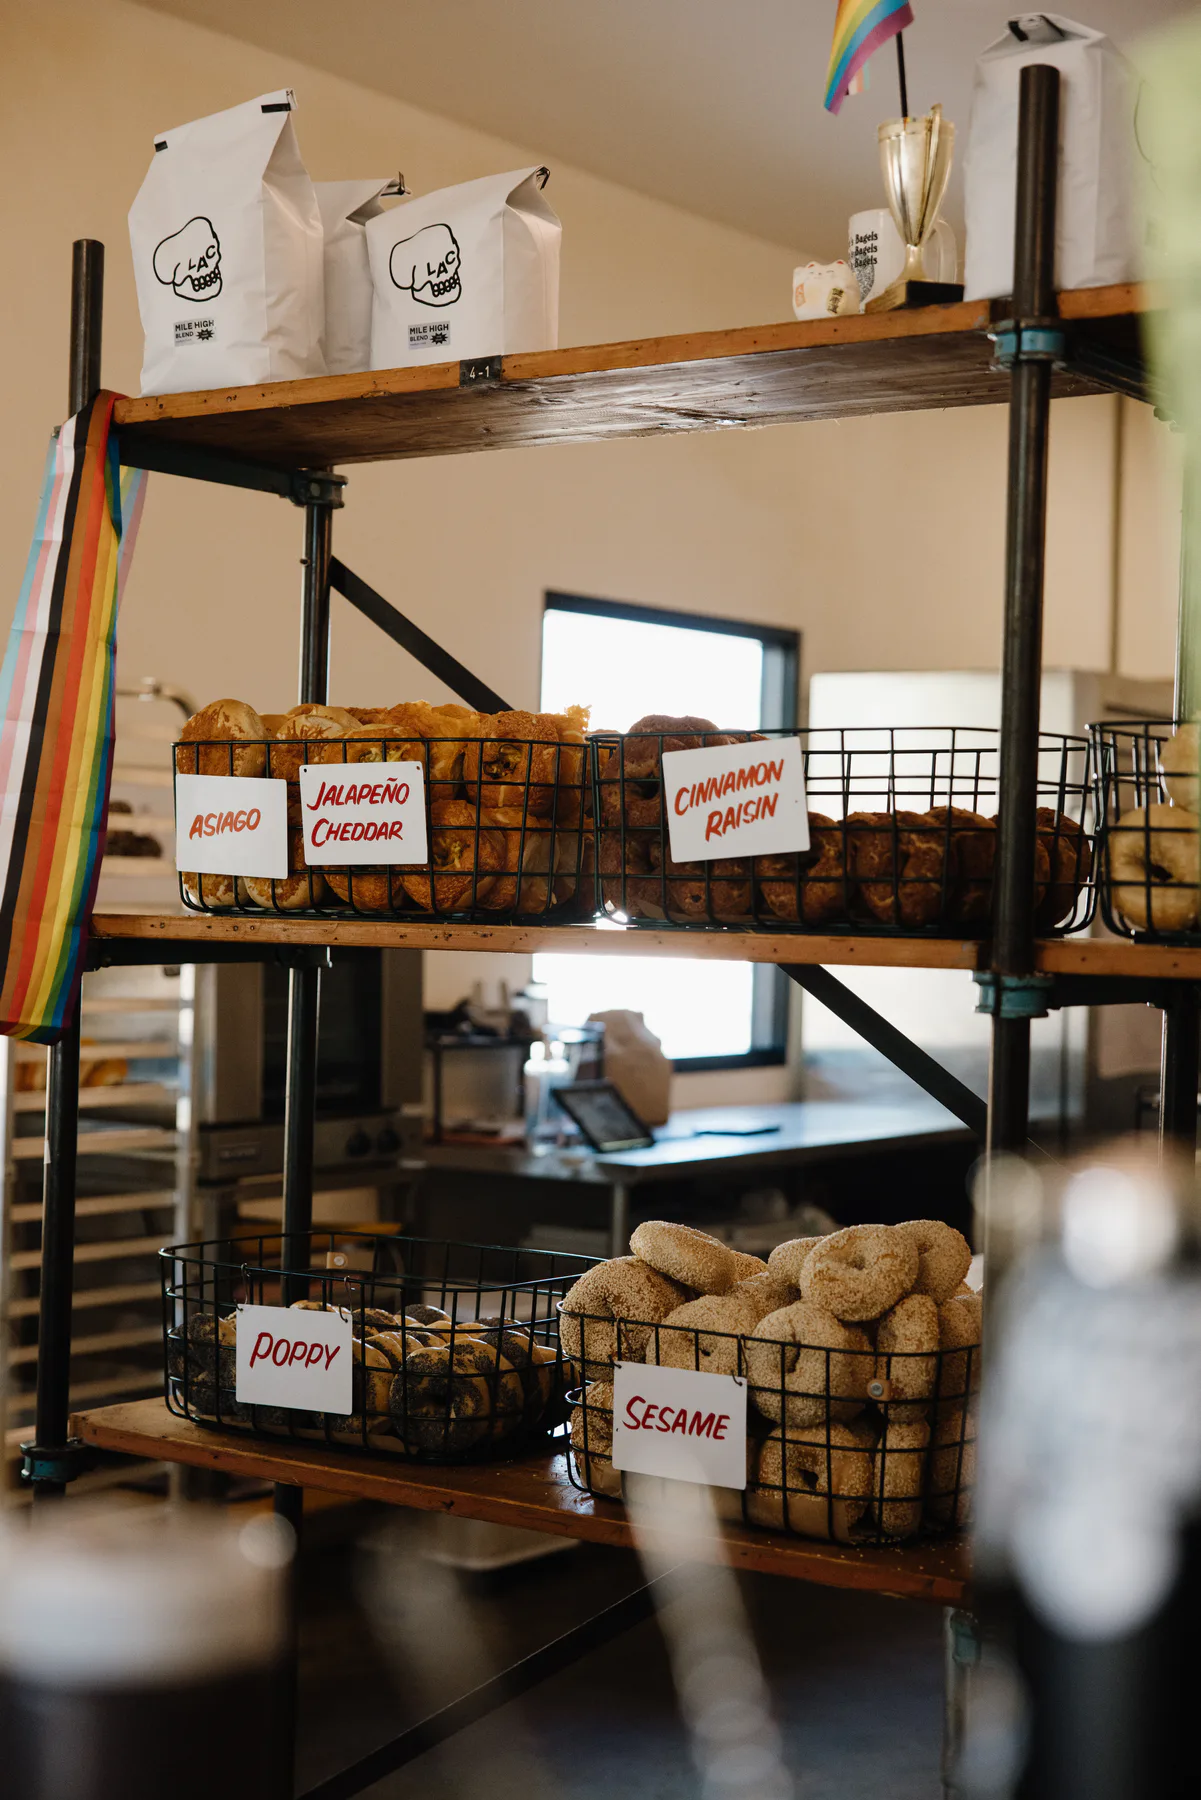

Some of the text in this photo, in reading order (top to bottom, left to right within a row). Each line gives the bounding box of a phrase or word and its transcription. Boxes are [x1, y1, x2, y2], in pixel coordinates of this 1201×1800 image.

[854, 243, 878, 256] Bagels
[855, 231, 878, 244] Bagels
[188, 244, 216, 273] LAC
[426, 250, 456, 279] LAC
[854, 255, 878, 268] Bagels
[175, 319, 215, 331] MILE HIGH
[175, 331, 194, 339] BLEND
[409, 323, 449, 335] MILE HIGH
[409, 334, 429, 342] BLEND
[305, 776, 411, 811] JALAPEÑO
[673, 759, 785, 817] CINNAMON
[188, 807, 262, 840] ASIAGO
[705, 792, 780, 842] RAISIN
[310, 817, 403, 848] CHEDDAR
[249, 1331, 341, 1371] POPPY
[623, 1395, 731, 1441] SESAME
